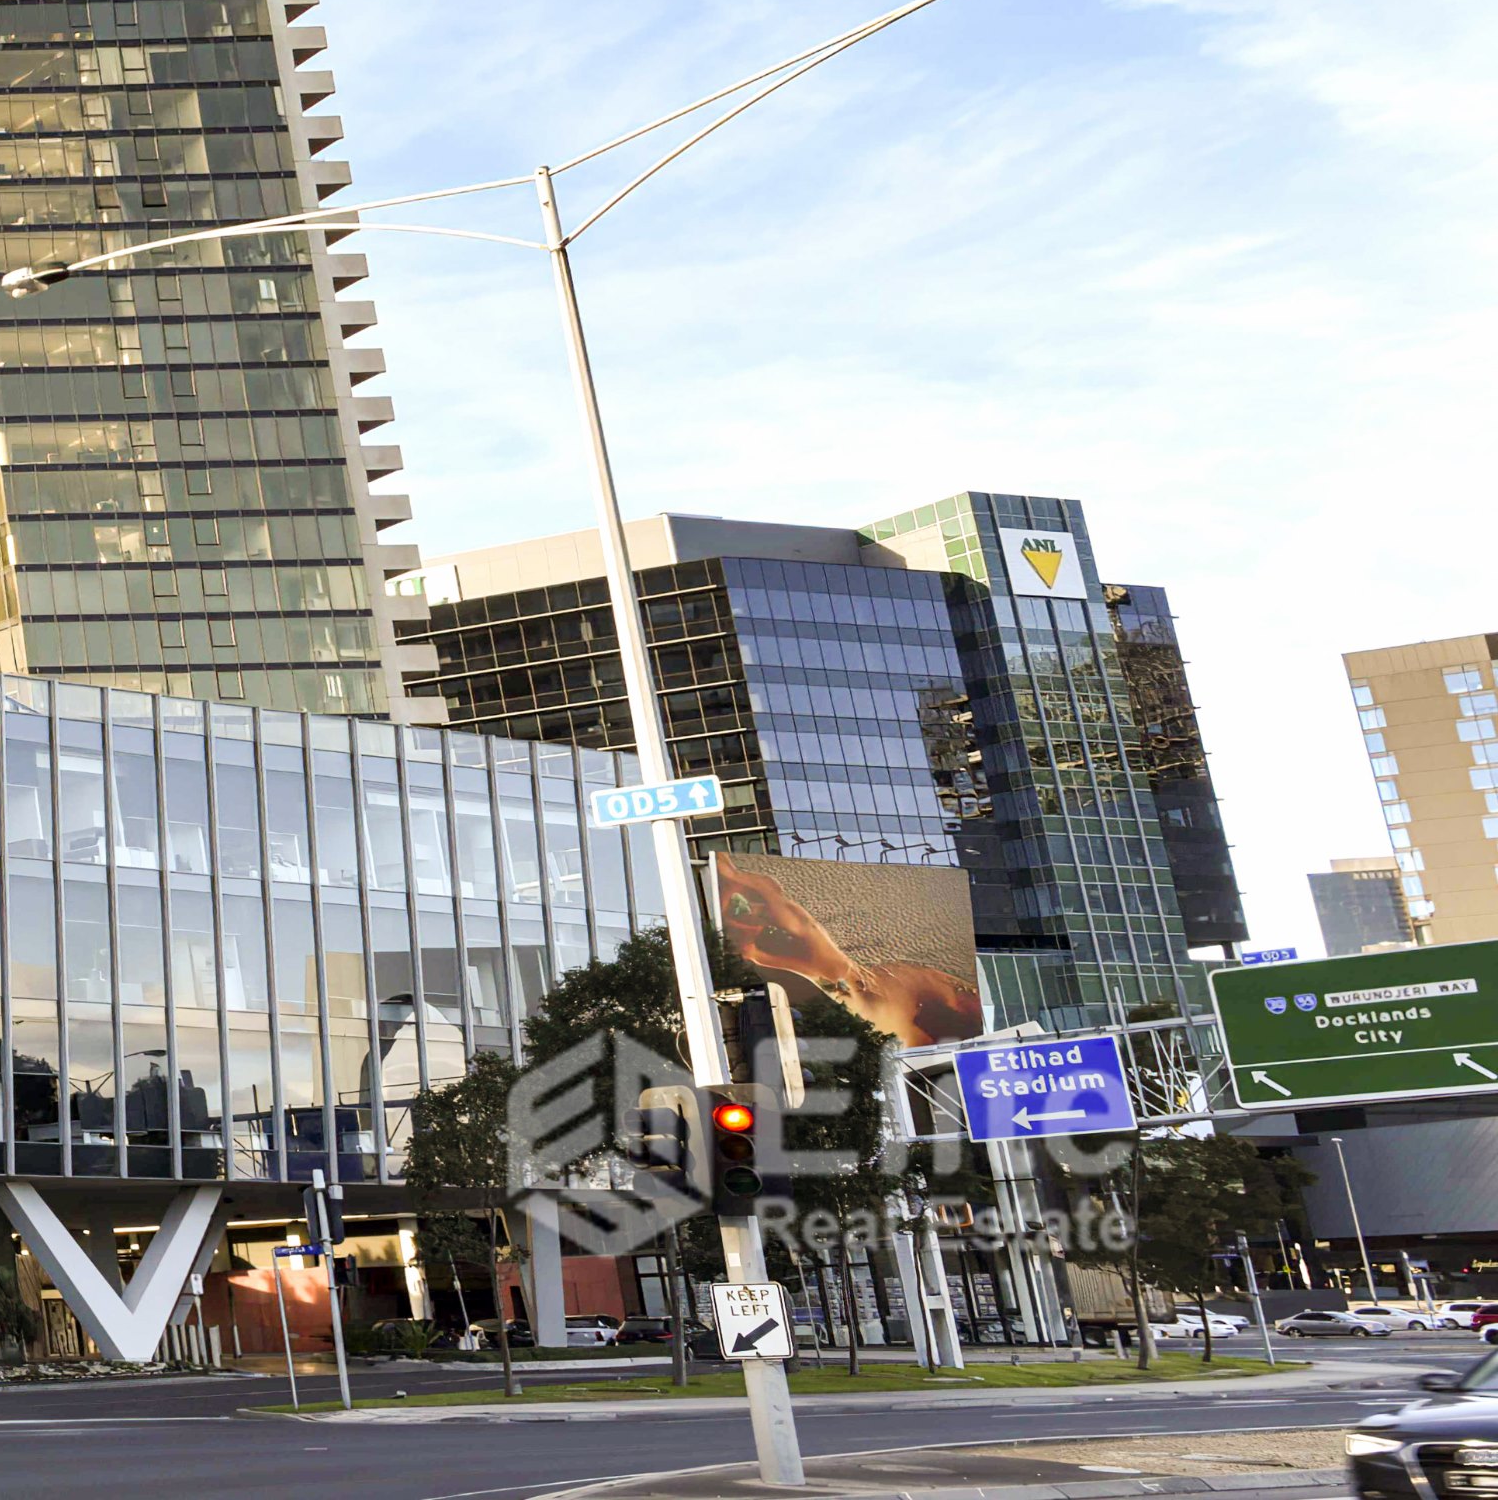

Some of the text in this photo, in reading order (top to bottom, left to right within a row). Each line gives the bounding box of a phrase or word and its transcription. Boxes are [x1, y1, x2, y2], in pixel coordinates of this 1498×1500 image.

[1021, 538, 1062, 553] ANL
[607, 787, 678, 818] OD5
[1439, 981, 1471, 992] WAY
[1315, 1007, 1432, 1029] Docklands
[1354, 1030, 1403, 1044] City
[988, 1045, 1083, 1072] Etihad
[980, 1073, 1105, 1099] Stadium
[726, 1289, 769, 1301] KEEP
[730, 1304, 769, 1316] LEFT
